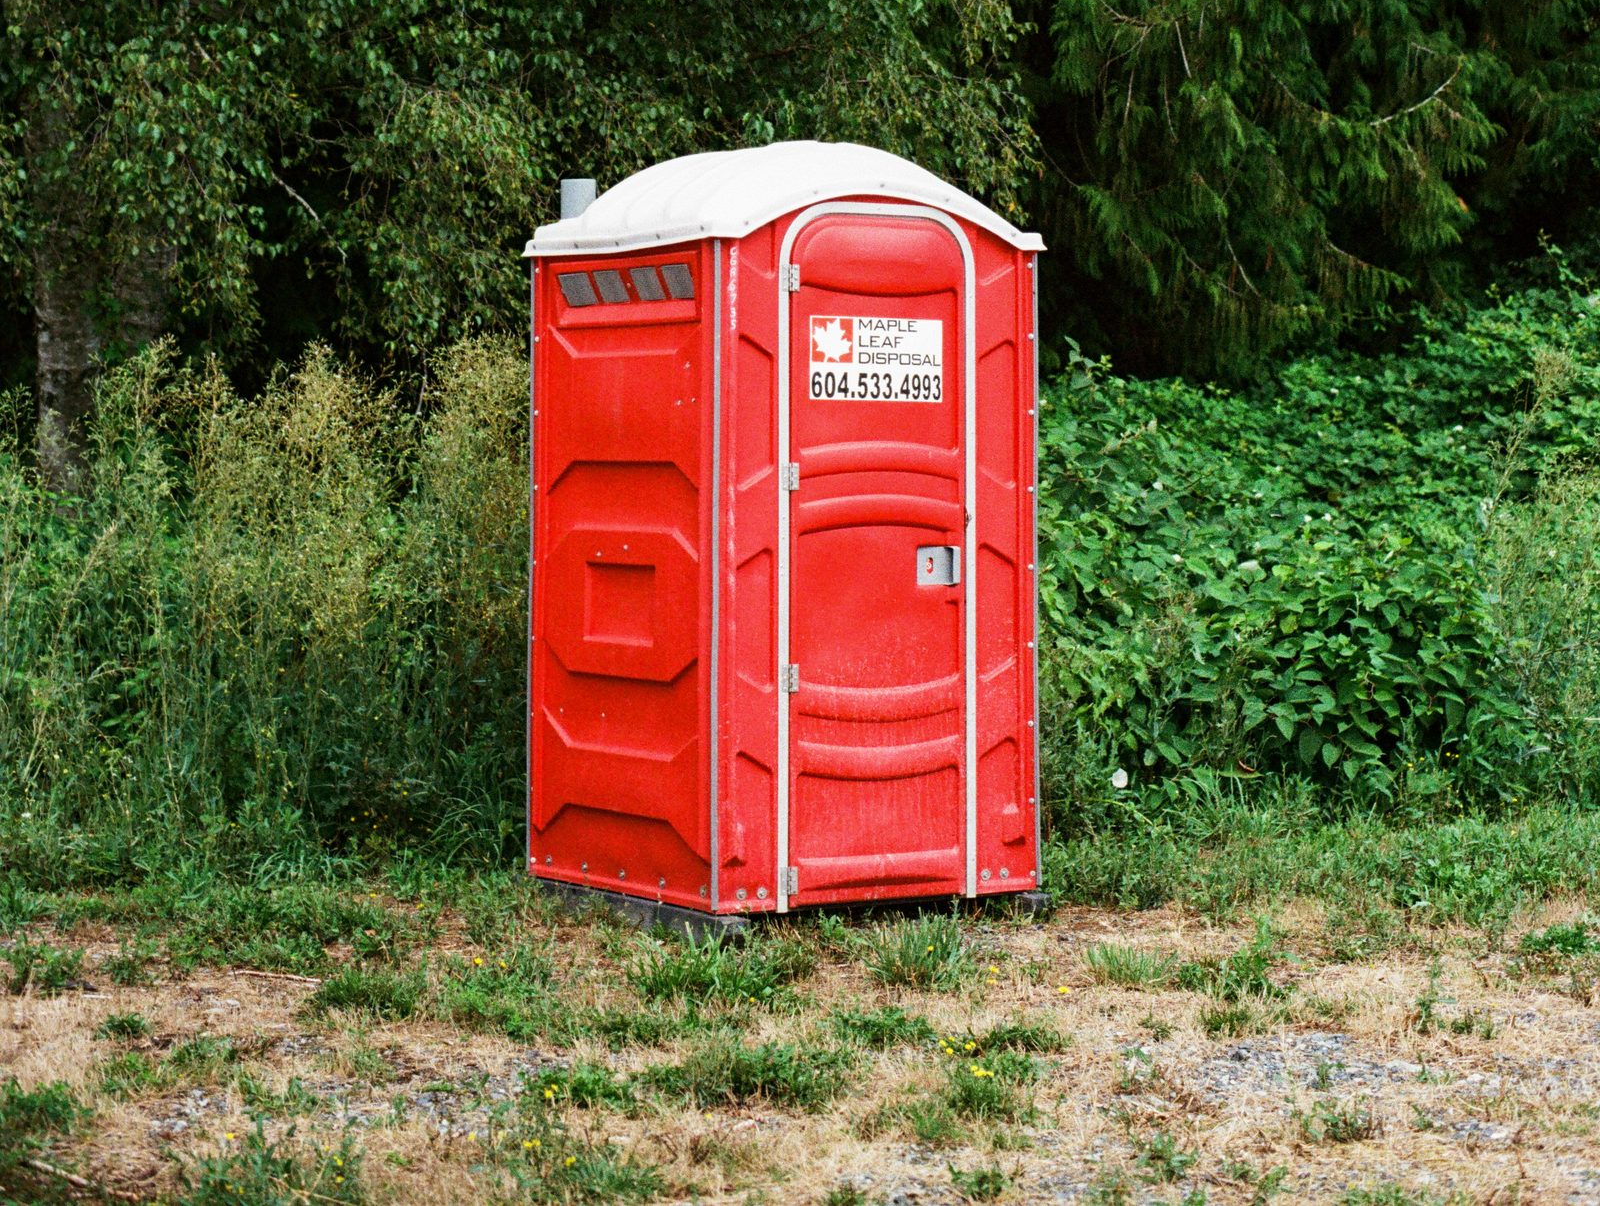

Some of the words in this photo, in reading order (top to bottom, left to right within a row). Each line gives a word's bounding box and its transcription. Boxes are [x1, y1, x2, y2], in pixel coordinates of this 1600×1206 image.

[859, 319, 918, 332] MAPLE
[859, 336, 903, 348] LEAF
[859, 352, 940, 366] DISPOSAL
[812, 372, 941, 400] 604.533.4993
